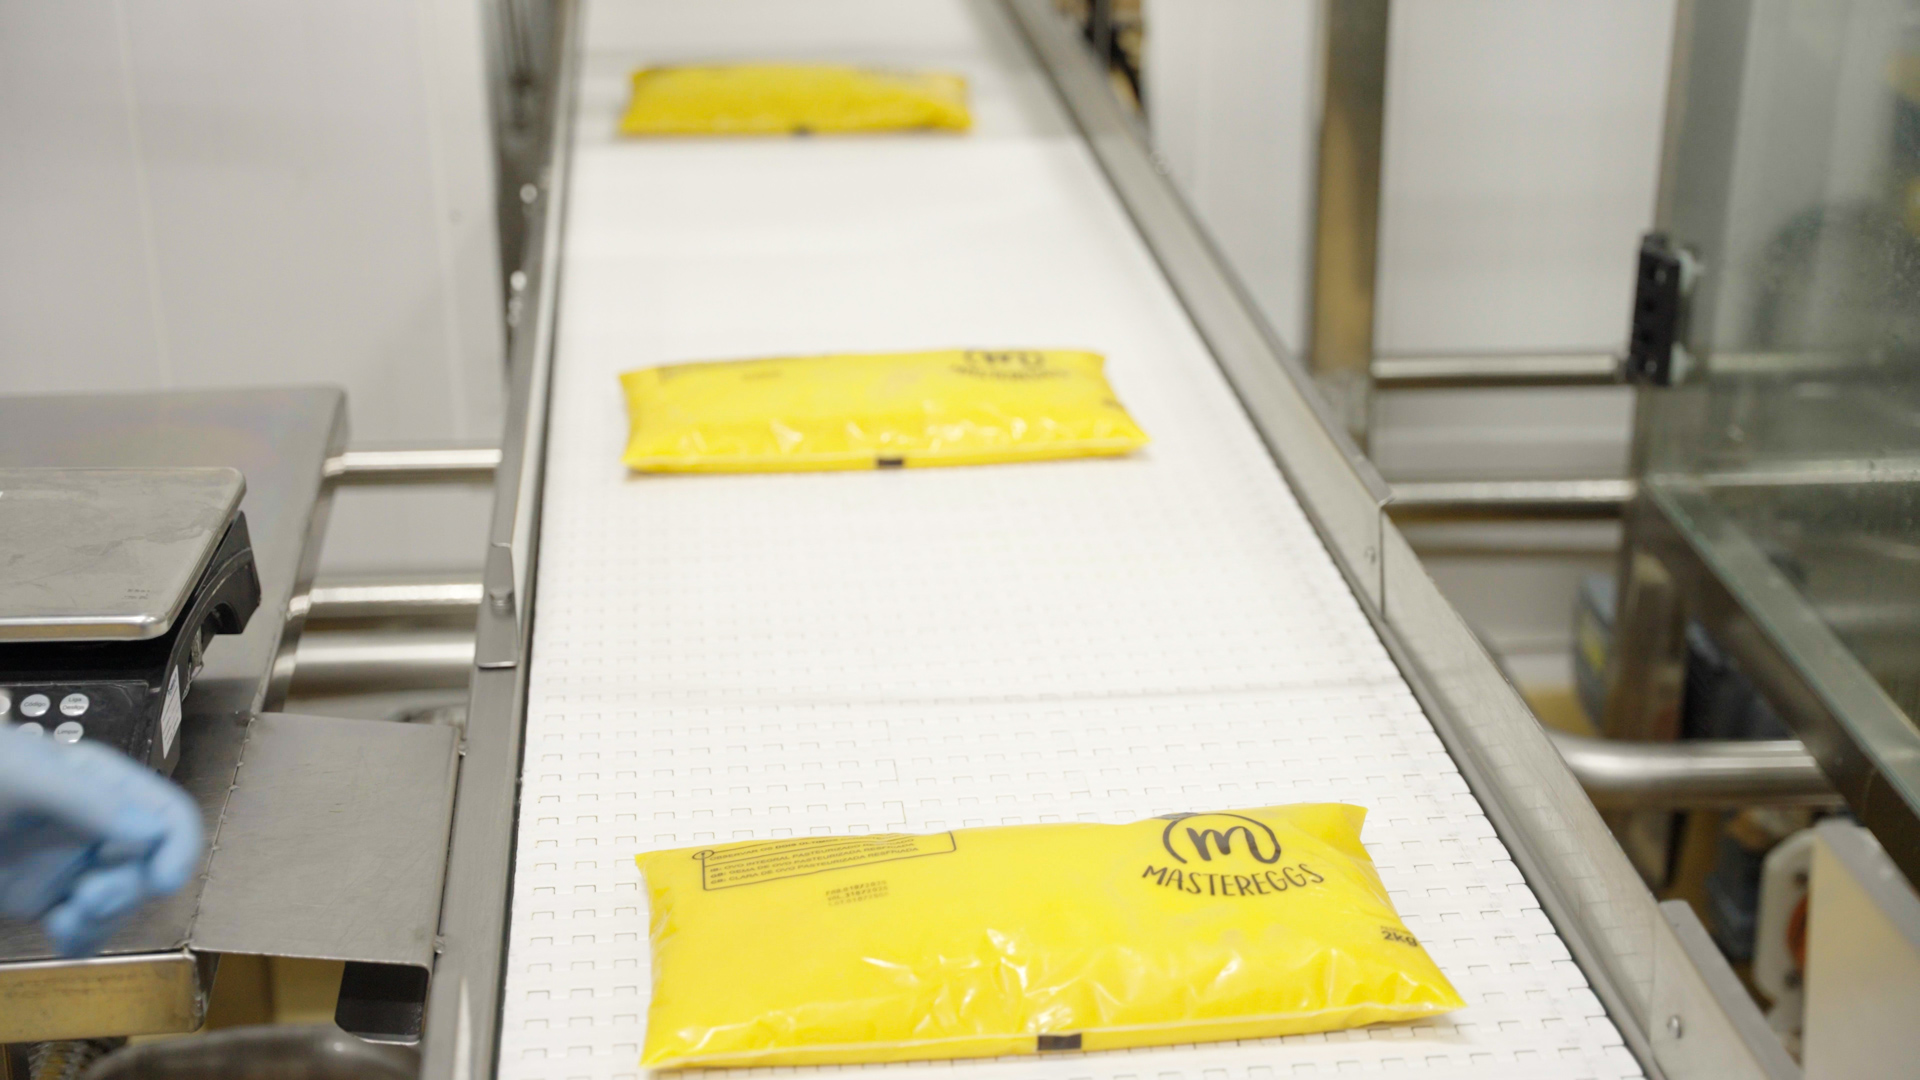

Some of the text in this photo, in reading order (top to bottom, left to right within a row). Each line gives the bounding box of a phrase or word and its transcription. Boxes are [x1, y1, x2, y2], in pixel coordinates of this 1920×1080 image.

[746, 855, 790, 867] INTEGRAL
[792, 843, 861, 859] PASTEURIZADO
[794, 848, 862, 864] PASTEURIZADA
[729, 872, 758, 882] CLARA
[797, 853, 866, 870] PASTEURIZADA
[1142, 864, 1325, 896] MASTEREGGS
[1381, 930, 1418, 947] 2kg
